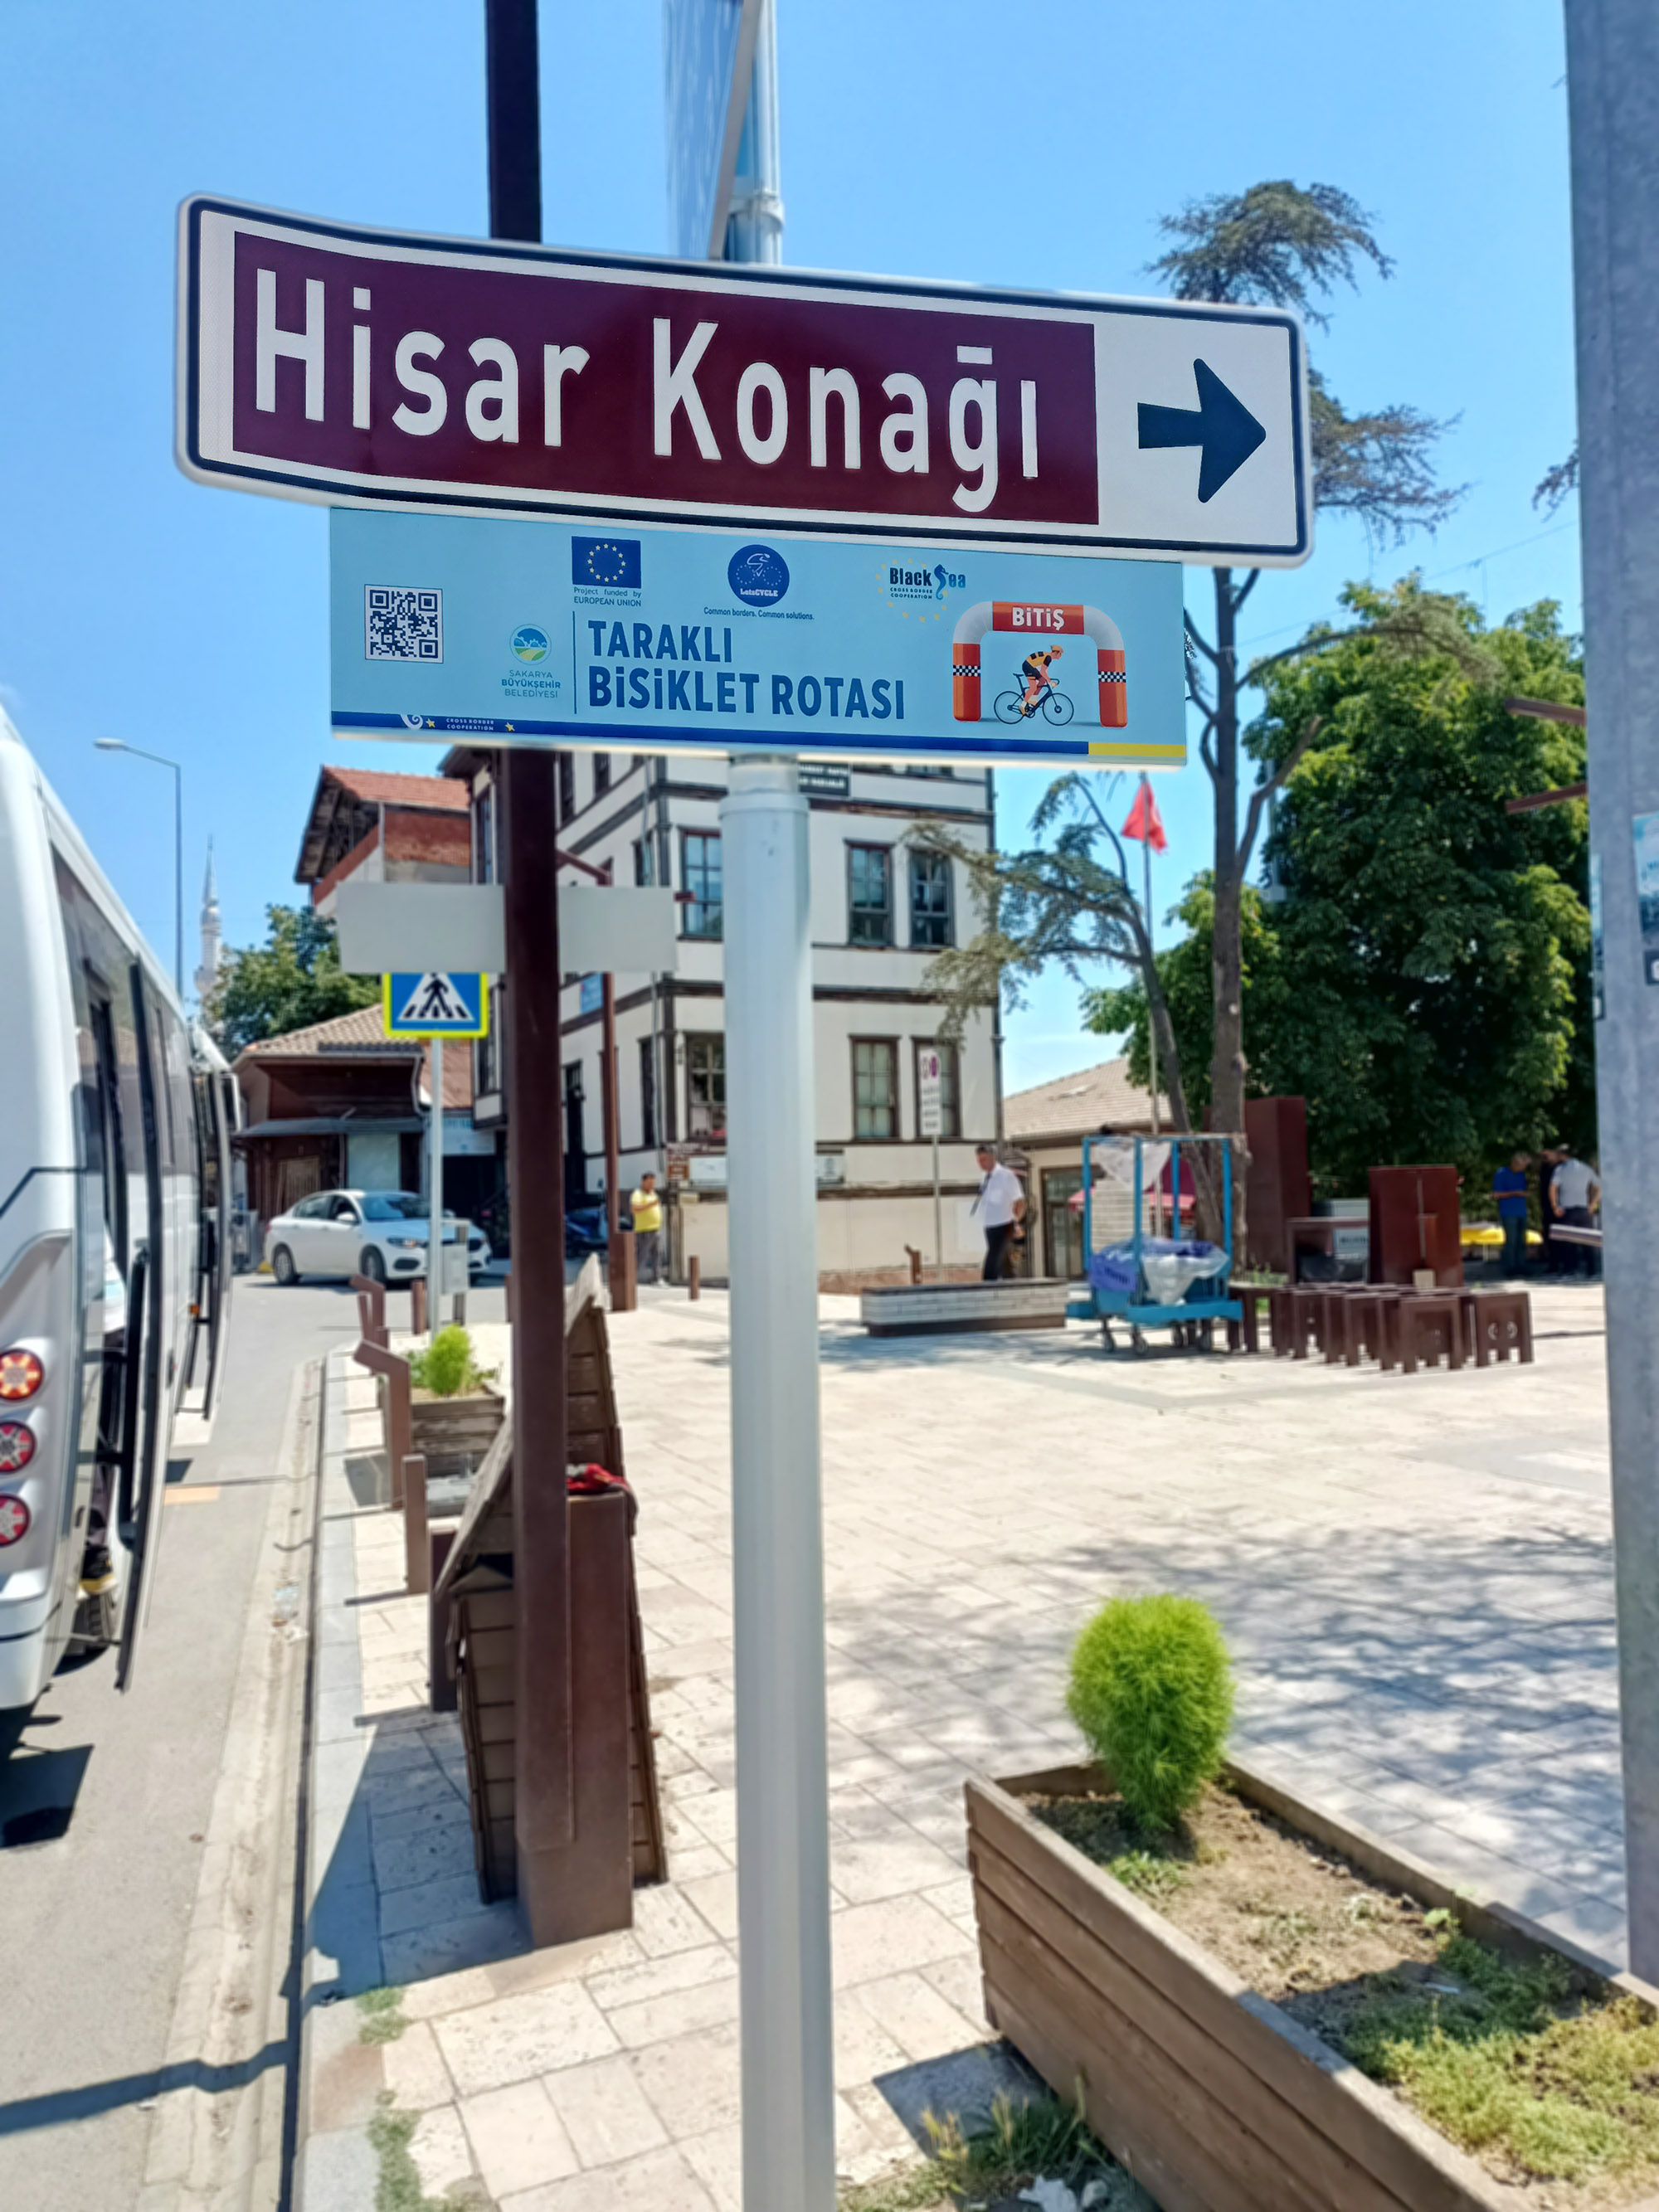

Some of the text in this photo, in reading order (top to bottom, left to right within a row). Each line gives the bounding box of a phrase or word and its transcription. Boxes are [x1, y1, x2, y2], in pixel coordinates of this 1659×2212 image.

[255, 269, 591, 447] Hisar
[890, 567, 932, 586] Black
[574, 587, 598, 596] Project
[740, 588, 778, 597] LetsCYCLE
[574, 596, 641, 607] EUROPEAN UNION
[703, 607, 815, 620] Common borders. Common solutions.
[588, 620, 732, 663] TARAKLI
[509, 669, 553, 678] SAKARYA
[501, 678, 561, 688] BÜYÜKŞEHİR
[771, 674, 905, 720] ROTASI
